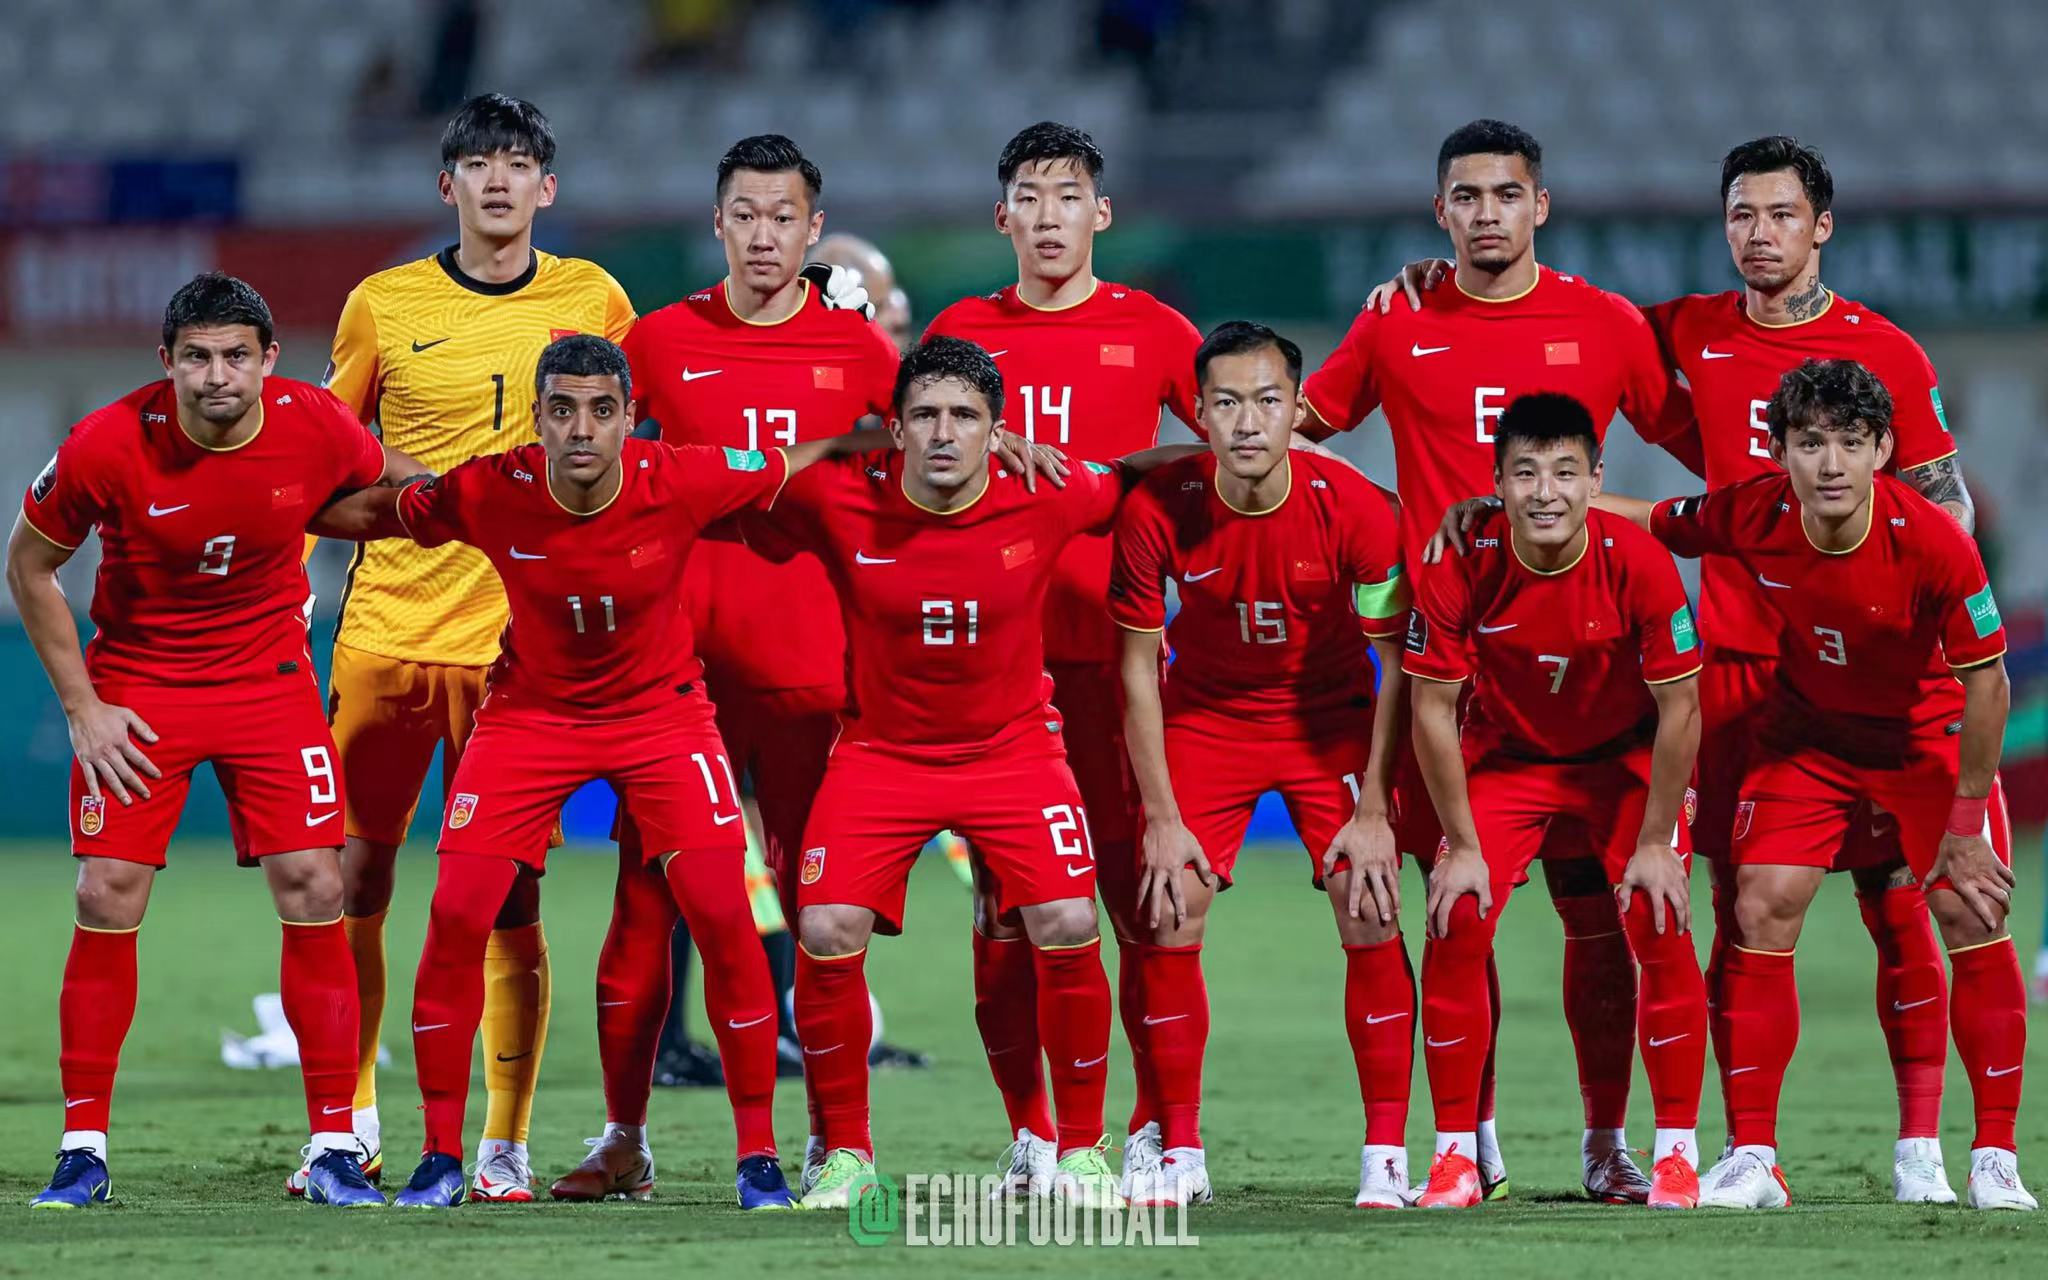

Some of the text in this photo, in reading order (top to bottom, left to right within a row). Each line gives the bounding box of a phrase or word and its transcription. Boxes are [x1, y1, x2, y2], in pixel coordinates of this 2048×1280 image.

[491, 374, 504, 431] 1
[1020, 386, 1072, 444] 14
[743, 408, 797, 451] 13
[198, 535, 236, 576] 9
[1475, 538, 1498, 548] CFA
[567, 595, 616, 634] 11
[921, 600, 978, 646] 21
[1235, 601, 1287, 645] 15
[1813, 626, 1848, 666] 3
[1538, 654, 1570, 694] 7
[301, 745, 337, 804] 9
[691, 752, 741, 809] 11
[1042, 803, 1095, 861] 21
